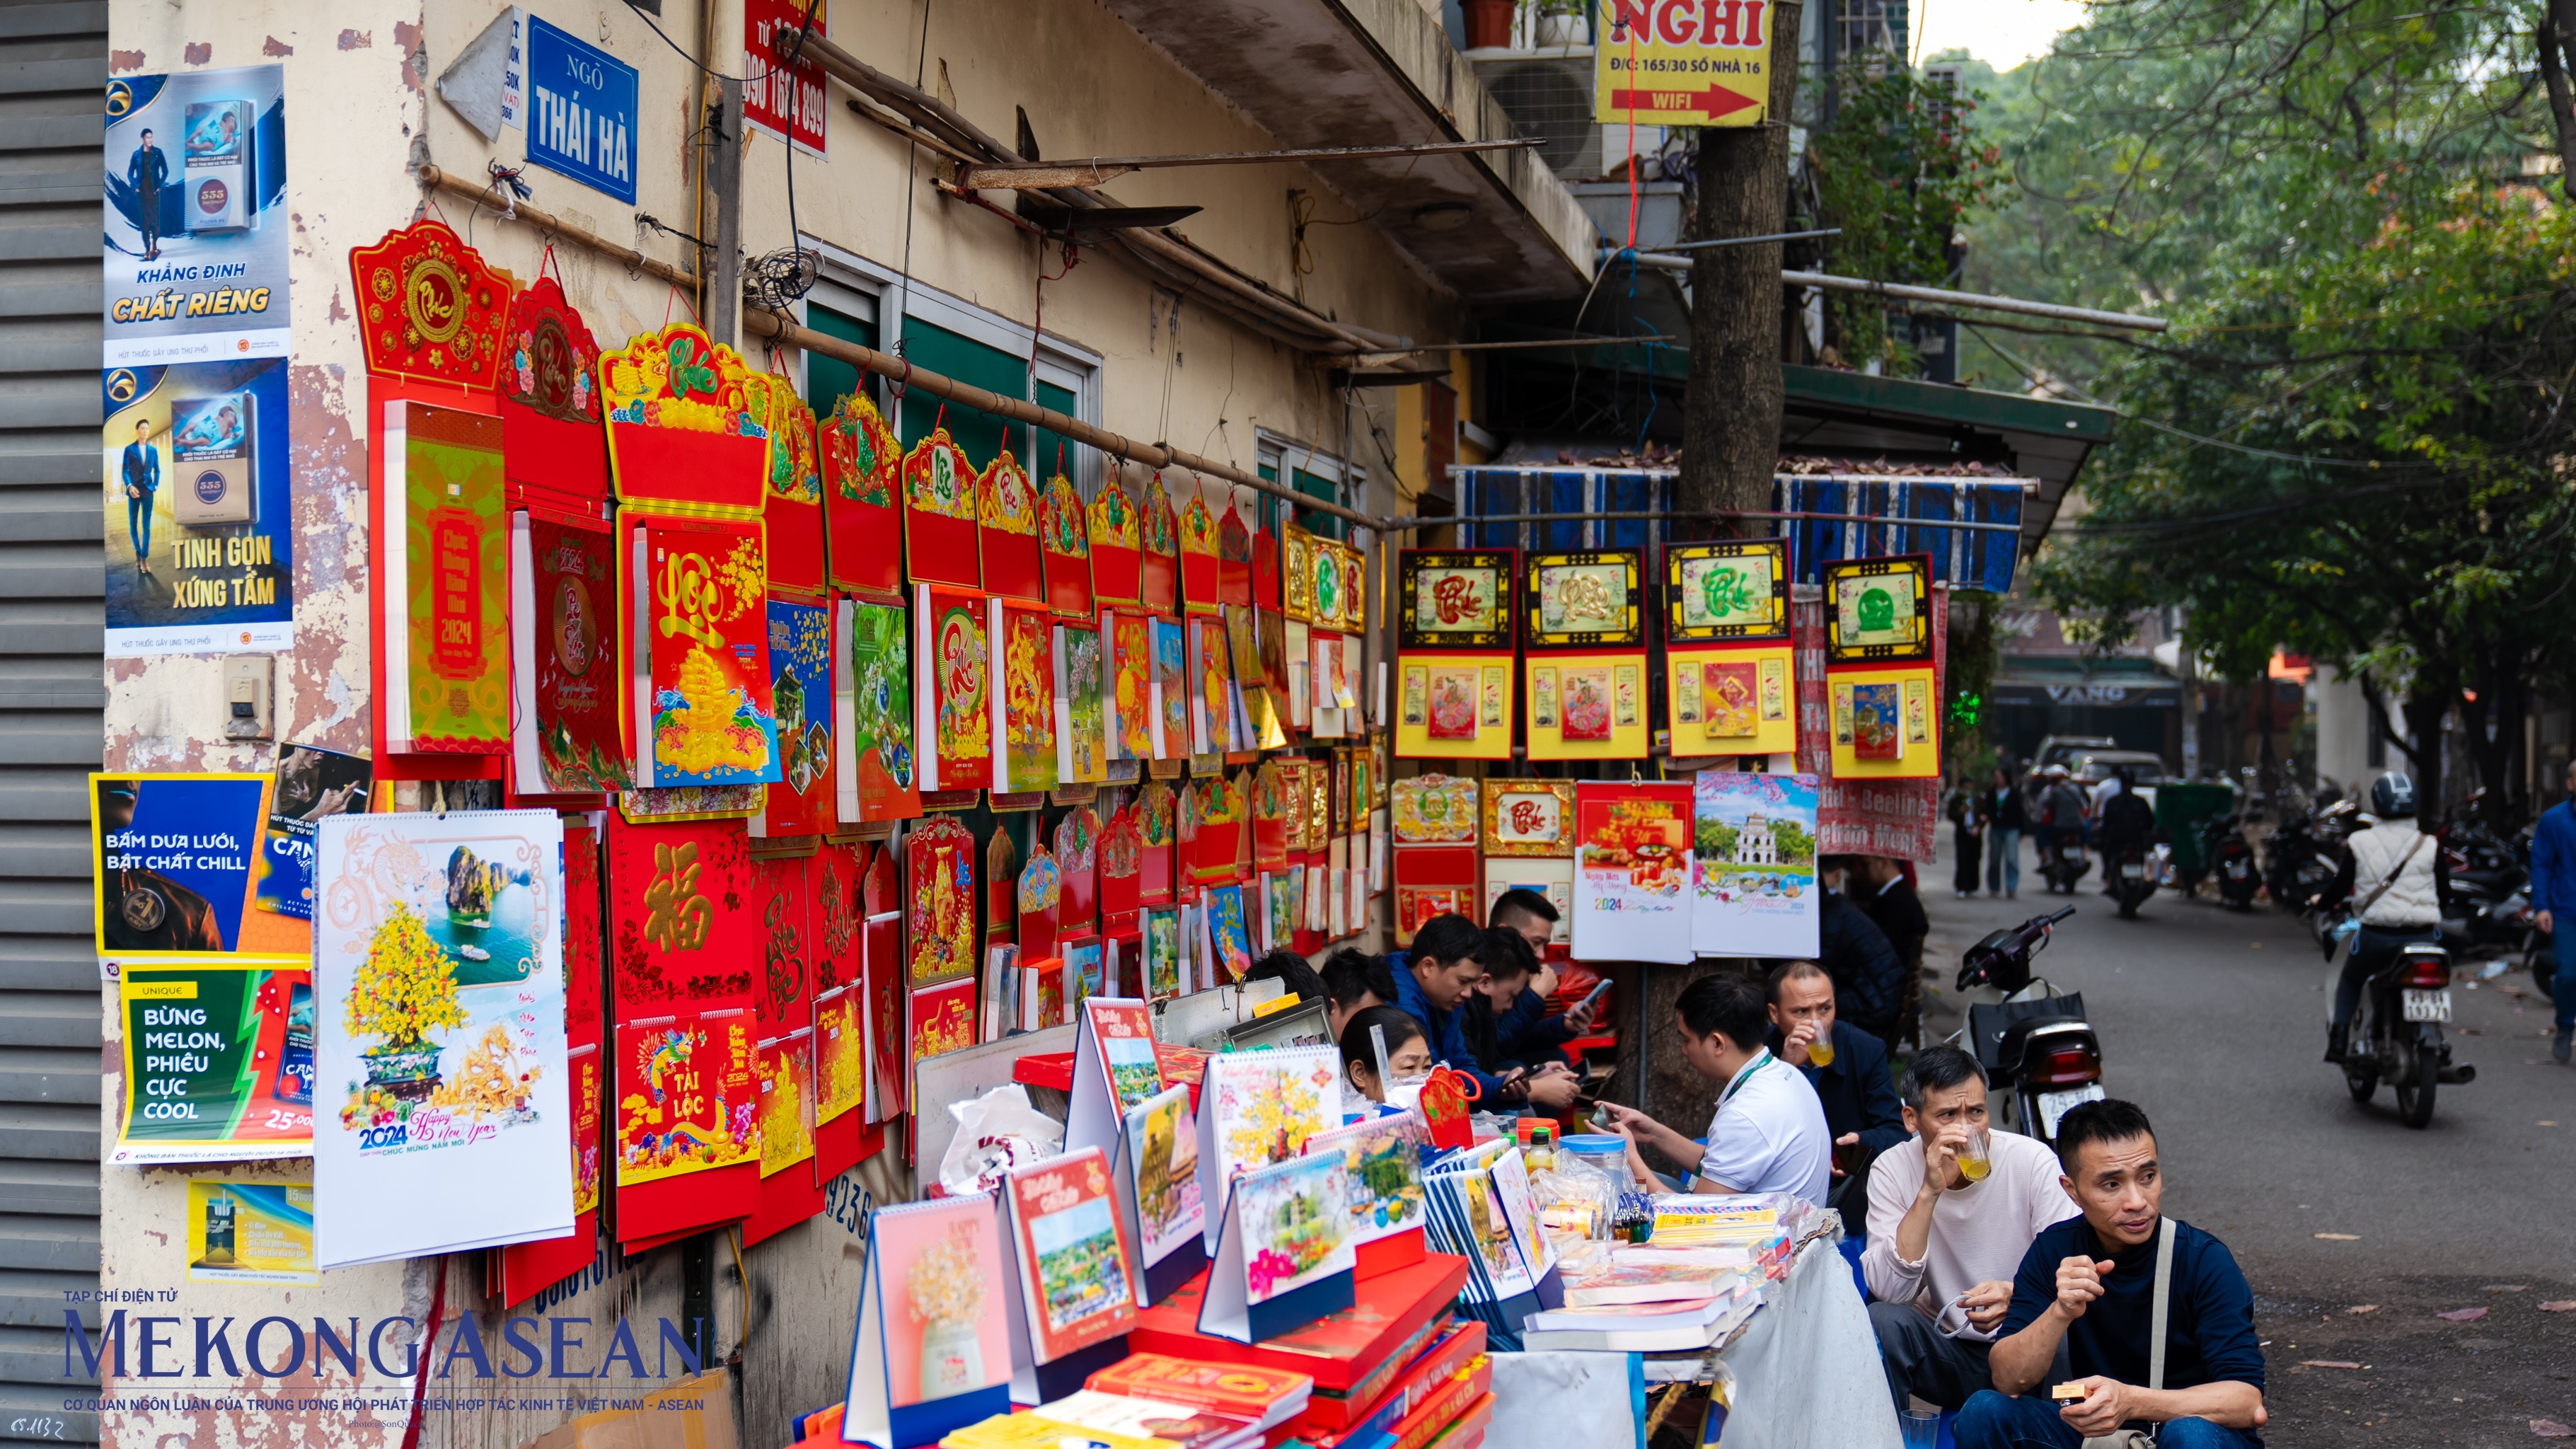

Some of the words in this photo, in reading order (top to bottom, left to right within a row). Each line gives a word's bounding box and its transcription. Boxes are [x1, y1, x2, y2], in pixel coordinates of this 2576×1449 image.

[757, 19, 770, 47] TỪ
[566, 54, 603, 91] NGÕ
[1643, 59, 1687, 72] 165/30
[1691, 56, 1709, 73] SỐ
[1712, 59, 1740, 74] NHÀ
[1745, 62, 1760, 74] 16
[744, 50, 767, 110] 090
[802, 81, 824, 137] 899
[1652, 93, 1692, 109] WIFI
[536, 84, 591, 166] THÁI
[599, 111, 629, 183] HÀ
[201, 190, 224, 200] 555
[202, 262, 246, 282] ĐỊNH
[112, 287, 185, 324] CHẤT
[186, 285, 270, 318] RIÊNG
[419, 280, 454, 322] Phúc
[200, 480, 221, 490] 555
[171, 538, 221, 569] TINH
[227, 536, 271, 571] GỌN
[173, 575, 226, 608] XỨNG
[231, 570, 275, 606] TẦM
[657, 552, 725, 650] Lộc
[441, 618, 472, 645] 2024
[943, 620, 977, 700] Phúc
[1862, 787, 1929, 818] Beeline
[106, 830, 146, 848] BẤM
[151, 833, 188, 848] DƯA
[193, 833, 239, 851] LƯỚI,
[107, 853, 143, 872] BẬT
[146, 852, 193, 870] CHẤT
[197, 856, 246, 870] CHILL
[287, 899, 312, 909] ACTIVA
[645, 841, 713, 954] 福
[1595, 897, 1622, 911] 2024
[142, 986, 183, 996] UNIQUE
[144, 1005, 207, 1026] BỪNG
[145, 1032, 226, 1052] MELON,
[728, 1024, 745, 1039] Chúc
[728, 1036, 748, 1050] Mừng
[730, 1047, 746, 1059] Năm
[146, 1053, 209, 1073] PHIÊU
[674, 1068, 699, 1092] TÀI
[727, 1072, 749, 1083] 2024
[146, 1078, 187, 1101] CỰC
[144, 1102, 199, 1119] COOL
[674, 1092, 704, 1121] LỘC
[264, 1109, 314, 1131] 25,00
[410, 1108, 451, 1141] Happy
[438, 1126, 465, 1141] New
[468, 1123, 497, 1145] Year
[359, 1125, 408, 1150] 2024
[382, 1147, 403, 1156] CHÚC
[407, 1143, 429, 1153] MỪNG
[432, 1140, 449, 1149] NĂM
[451, 1138, 466, 1147] MỚI
